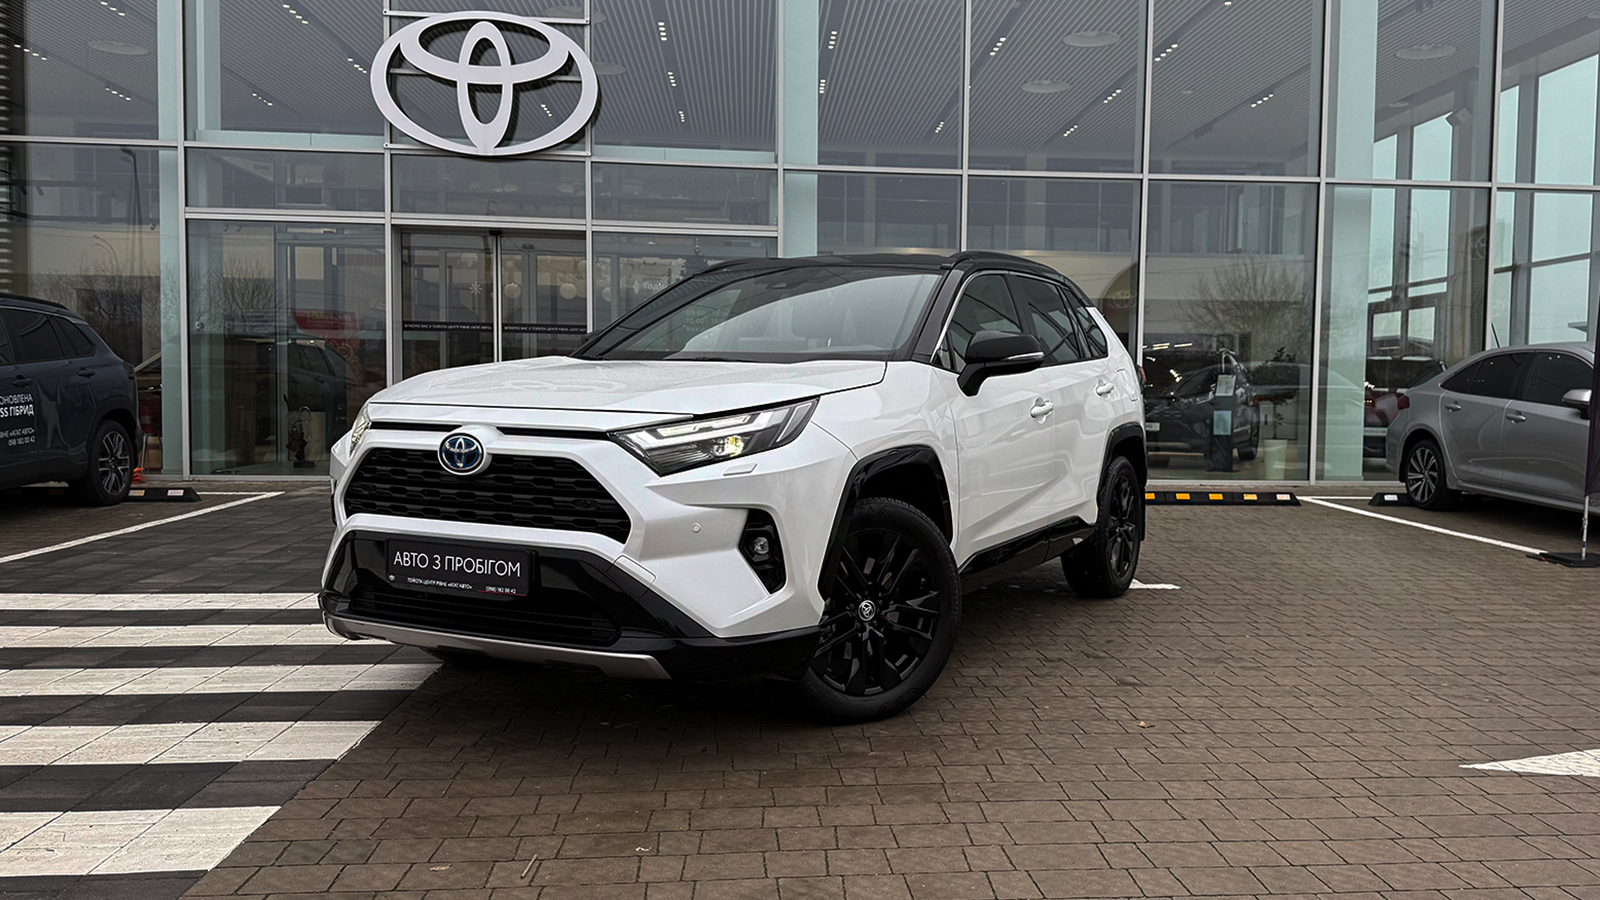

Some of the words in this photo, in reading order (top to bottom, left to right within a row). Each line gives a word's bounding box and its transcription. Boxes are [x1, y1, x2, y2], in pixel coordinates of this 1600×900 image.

[10, 404, 35, 417] ГІБРИД
[393, 551, 429, 568] АВТО
[445, 555, 521, 578] ПРОБІГОМ
